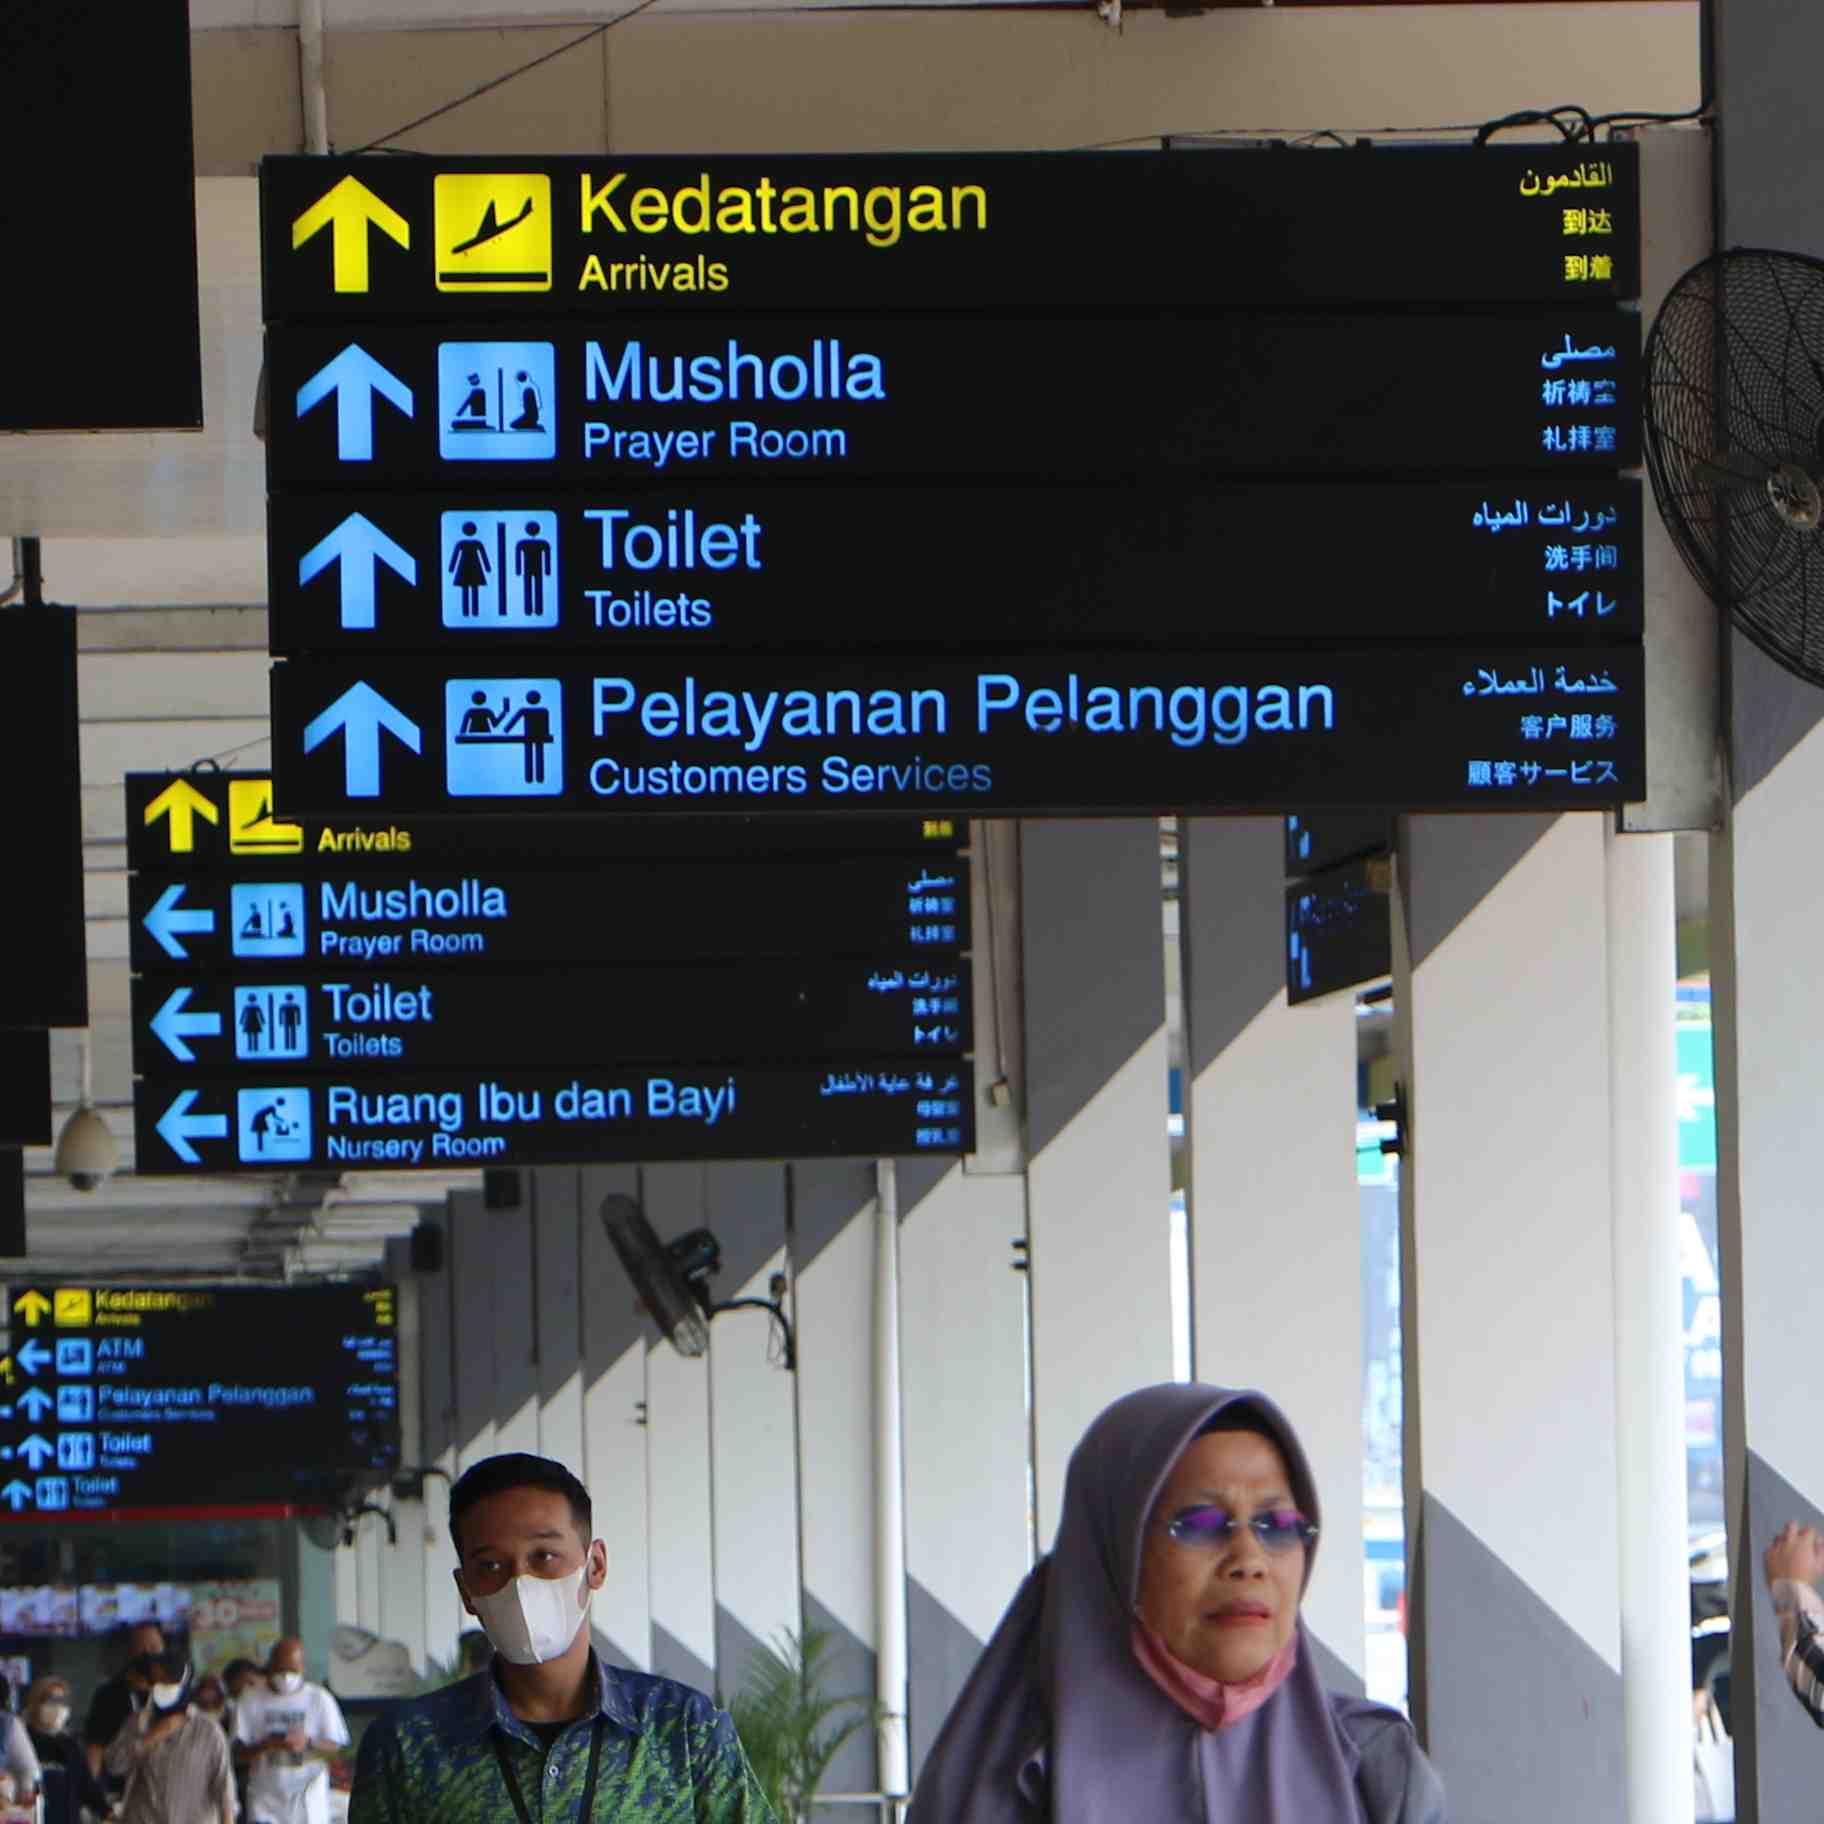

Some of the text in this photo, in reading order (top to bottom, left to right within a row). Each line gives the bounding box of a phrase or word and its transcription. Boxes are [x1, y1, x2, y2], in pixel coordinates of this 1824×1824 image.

[580, 173, 988, 247] Kedatangan
[1563, 208, 1610, 235] 到达
[578, 254, 730, 292] Arrivals
[585, 339, 887, 403] Musholla
[584, 421, 848, 469] Prayer Room
[583, 509, 763, 571] Toilet
[583, 590, 714, 628] Toilets
[1547, 591, 1617, 617] トイレ
[592, 673, 1336, 748] Pelayanan Pelanggan
[589, 755, 993, 795] Customers Services
[317, 826, 412, 852] Arrivals
[321, 879, 508, 921] Musholla
[320, 929, 485, 959] Prayer Room
[322, 983, 434, 1023] Toilet
[324, 1033, 404, 1057] Toilets
[328, 1078, 737, 1129] Ruang Ibu dan Bayi
[327, 1132, 506, 1163] Nursery Room
[97, 1337, 144, 1358] ATM
[100, 1432, 152, 1453] Toilet
